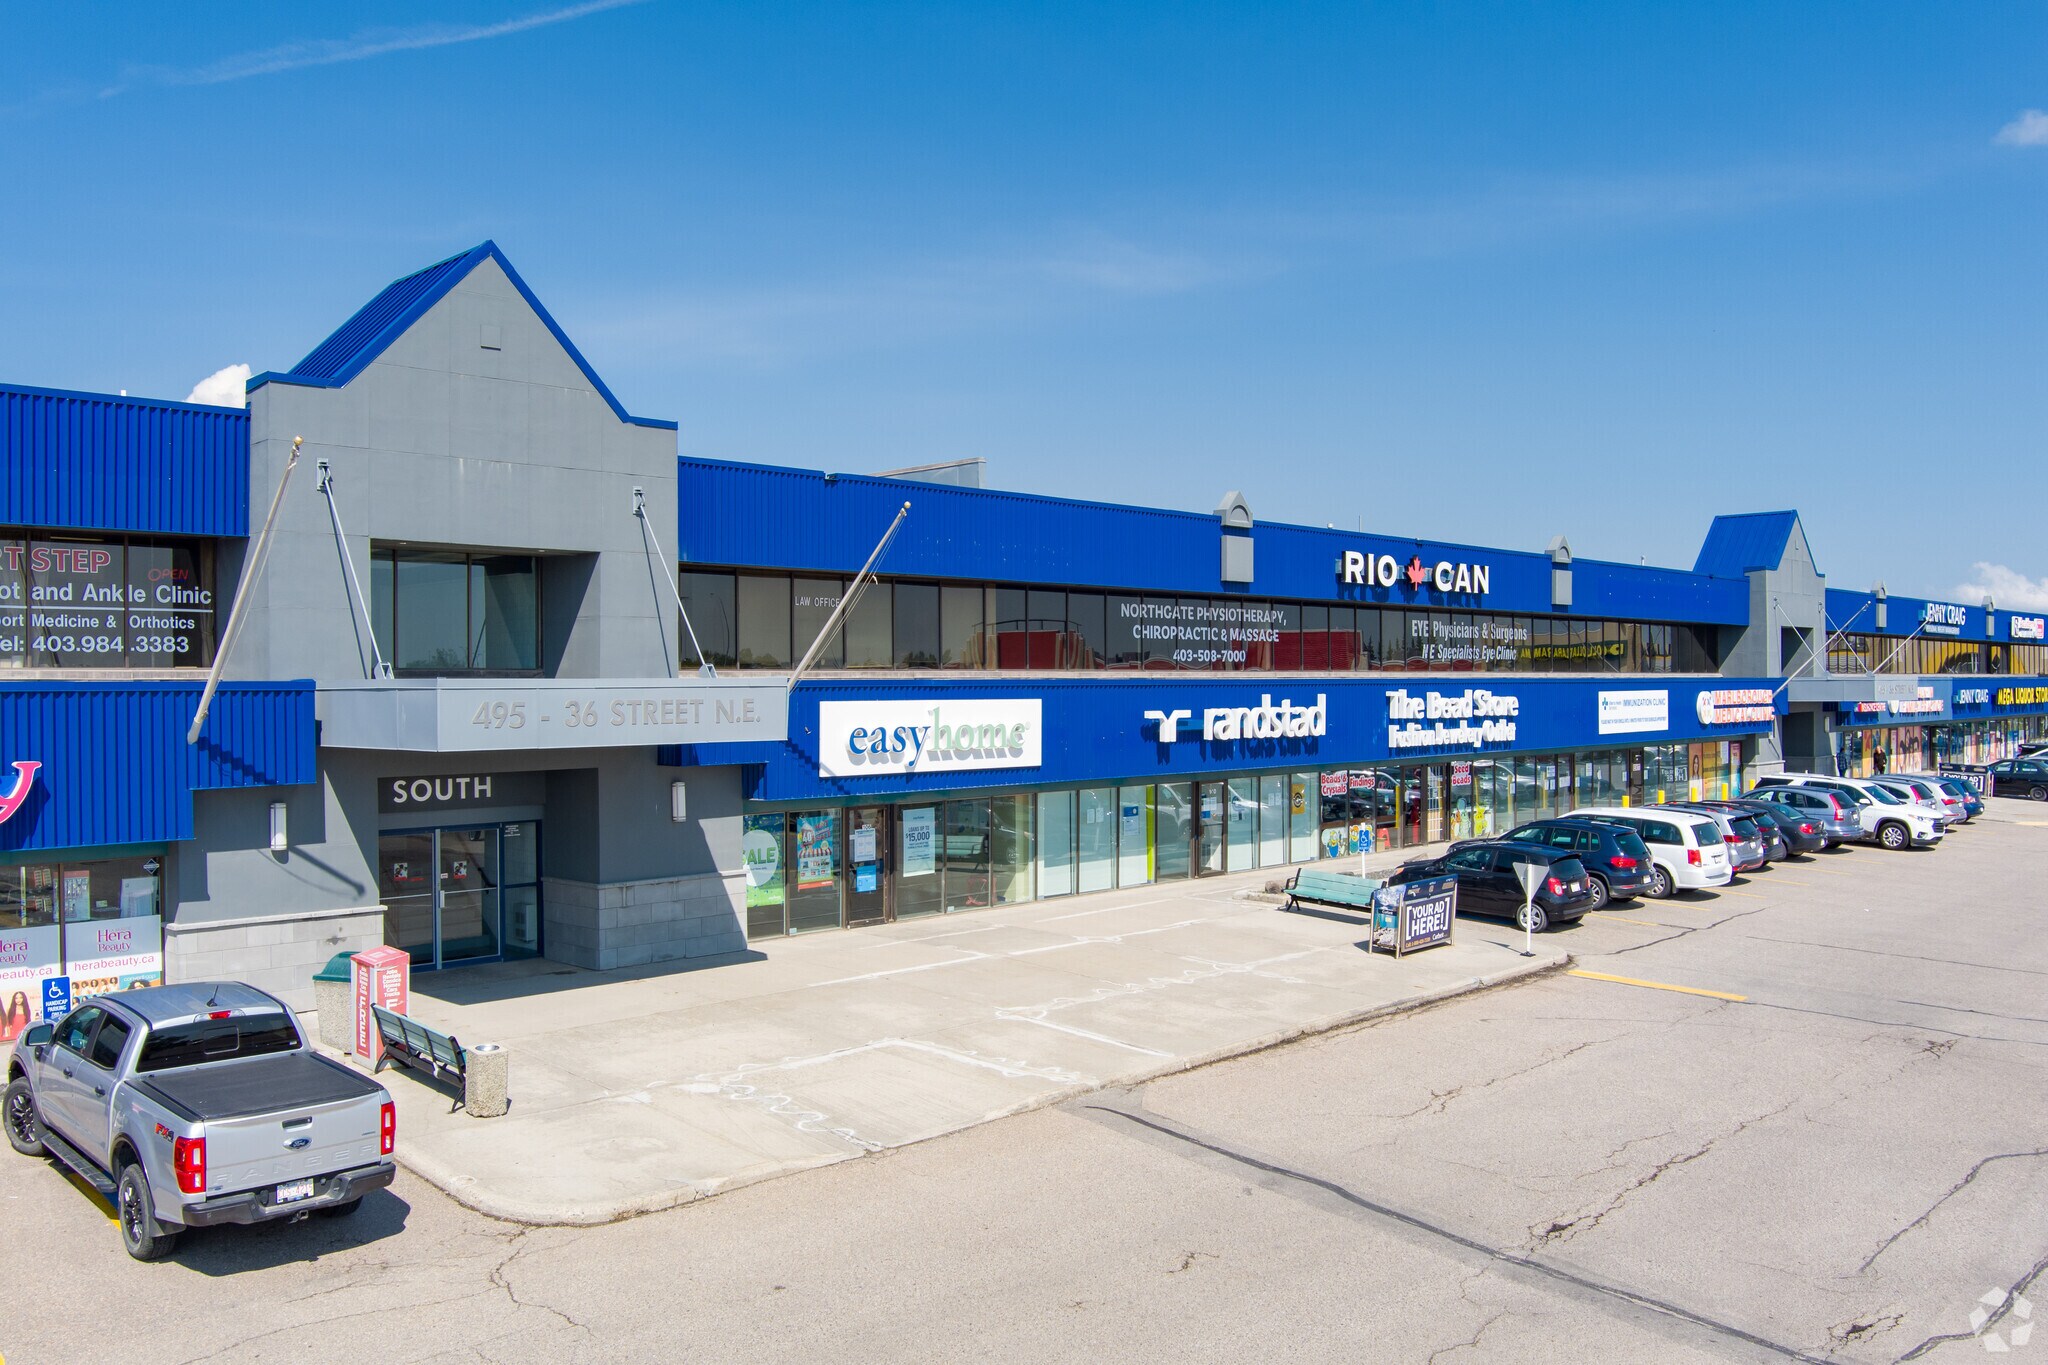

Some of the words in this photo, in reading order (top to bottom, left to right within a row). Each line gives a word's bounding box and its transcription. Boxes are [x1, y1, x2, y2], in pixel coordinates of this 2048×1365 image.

[31, 548, 111, 573] STEP
[147, 568, 189, 582] OPEN
[1344, 550, 1398, 587] RIO
[1434, 561, 1490, 594] CAN
[31, 583, 73, 601] and
[156, 585, 212, 604] Clinic
[794, 596, 811, 606] LAW
[814, 597, 841, 607] OFFICE
[31, 614, 100, 628] Medicine
[105, 615, 117, 628] &
[129, 616, 195, 630] Orthotics
[1121, 603, 1195, 620] NORTHGATE
[1196, 606, 1287, 626] PHYSIOTHERAPY,
[1923, 603, 1947, 623] JENNY
[1947, 605, 1966, 626] CRAIG
[1133, 624, 1219, 641] CHIROPRACTIC
[1220, 628, 1228, 642] &
[1229, 627, 1280, 642] MASSAGE
[1411, 620, 1429, 637] EYE
[1433, 621, 1480, 641] Physicians
[1481, 622, 1489, 640] &
[1491, 623, 1528, 644] Surgeons
[1172, 648, 1247, 662] 403-508-7000
[1437, 644, 1480, 662] Specialists
[1481, 645, 1496, 663] Eye
[1496, 645, 1518, 660] Clinic
[1386, 689, 1425, 719] The
[1426, 689, 1473, 719] Bead
[1473, 689, 1519, 717] Store
[1713, 690, 1773, 705] MARLBOROUGH
[1957, 690, 1974, 704] JENNY
[1997, 688, 2014, 705] MEGA
[2015, 687, 2035, 704] LIQUOR
[472, 700, 526, 730] 495
[564, 700, 598, 728] 36
[610, 699, 704, 727] STREET
[715, 698, 761, 724] N.E.
[1203, 693, 1327, 741] randstad
[1713, 708, 1751, 723] MEDICAL
[848, 706, 1027, 768] easyhome
[1388, 722, 1435, 748] Fashion
[1482, 718, 1517, 742] Outlet
[1454, 764, 1469, 774] Seed
[1321, 774, 1340, 785] Beads
[1349, 777, 1375, 789] Findings
[1452, 774, 1471, 785] Beads
[393, 776, 492, 803] SOUTH
[1321, 785, 1347, 796] Crystals
[906, 831, 930, 842] $15,000
[1412, 904, 1434, 920] YOUR
[1434, 900, 1445, 915] AD
[1411, 912, 1445, 937] HERE!
[98, 929, 132, 942] Hera
[98, 942, 132, 953] Beauty
[74, 955, 155, 971] herabeauty.ca
[45, 999, 68, 1007] HANDICAP
[47, 1005, 67, 1013] PARKING
[154, 1122, 175, 1144] FX4
